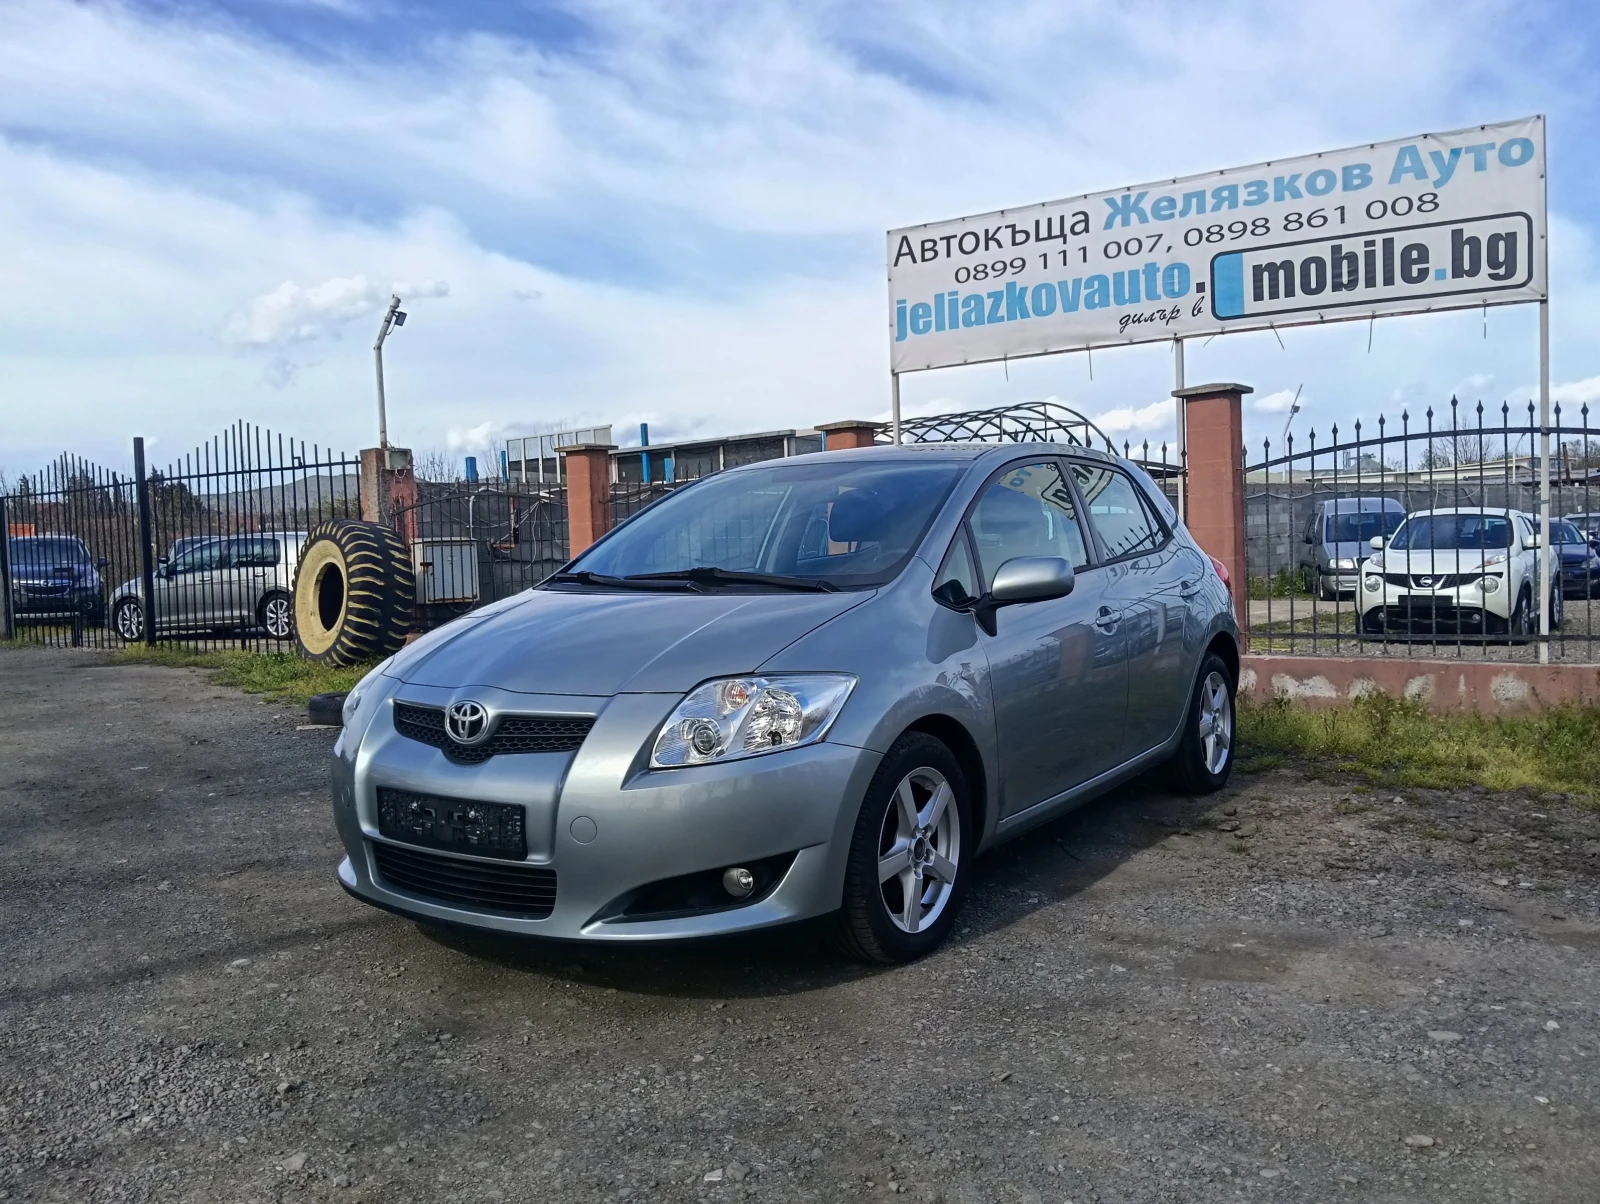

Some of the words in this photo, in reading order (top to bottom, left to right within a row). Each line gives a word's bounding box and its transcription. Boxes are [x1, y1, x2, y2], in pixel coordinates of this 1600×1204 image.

[893, 210, 1090, 267] Автокъща
[1103, 163, 1373, 230] Желязков
[1388, 137, 1535, 189] Ауто
[954, 257, 1026, 284] 0899
[1038, 246, 1088, 270] 111
[1103, 233, 1173, 259] 007,
[1183, 217, 1271, 248] 0898
[1283, 205, 1346, 231] 861
[1365, 192, 1440, 219] 008
[1252, 228, 1518, 302] mobile.bg
[1119, 304, 1182, 334] дилър
